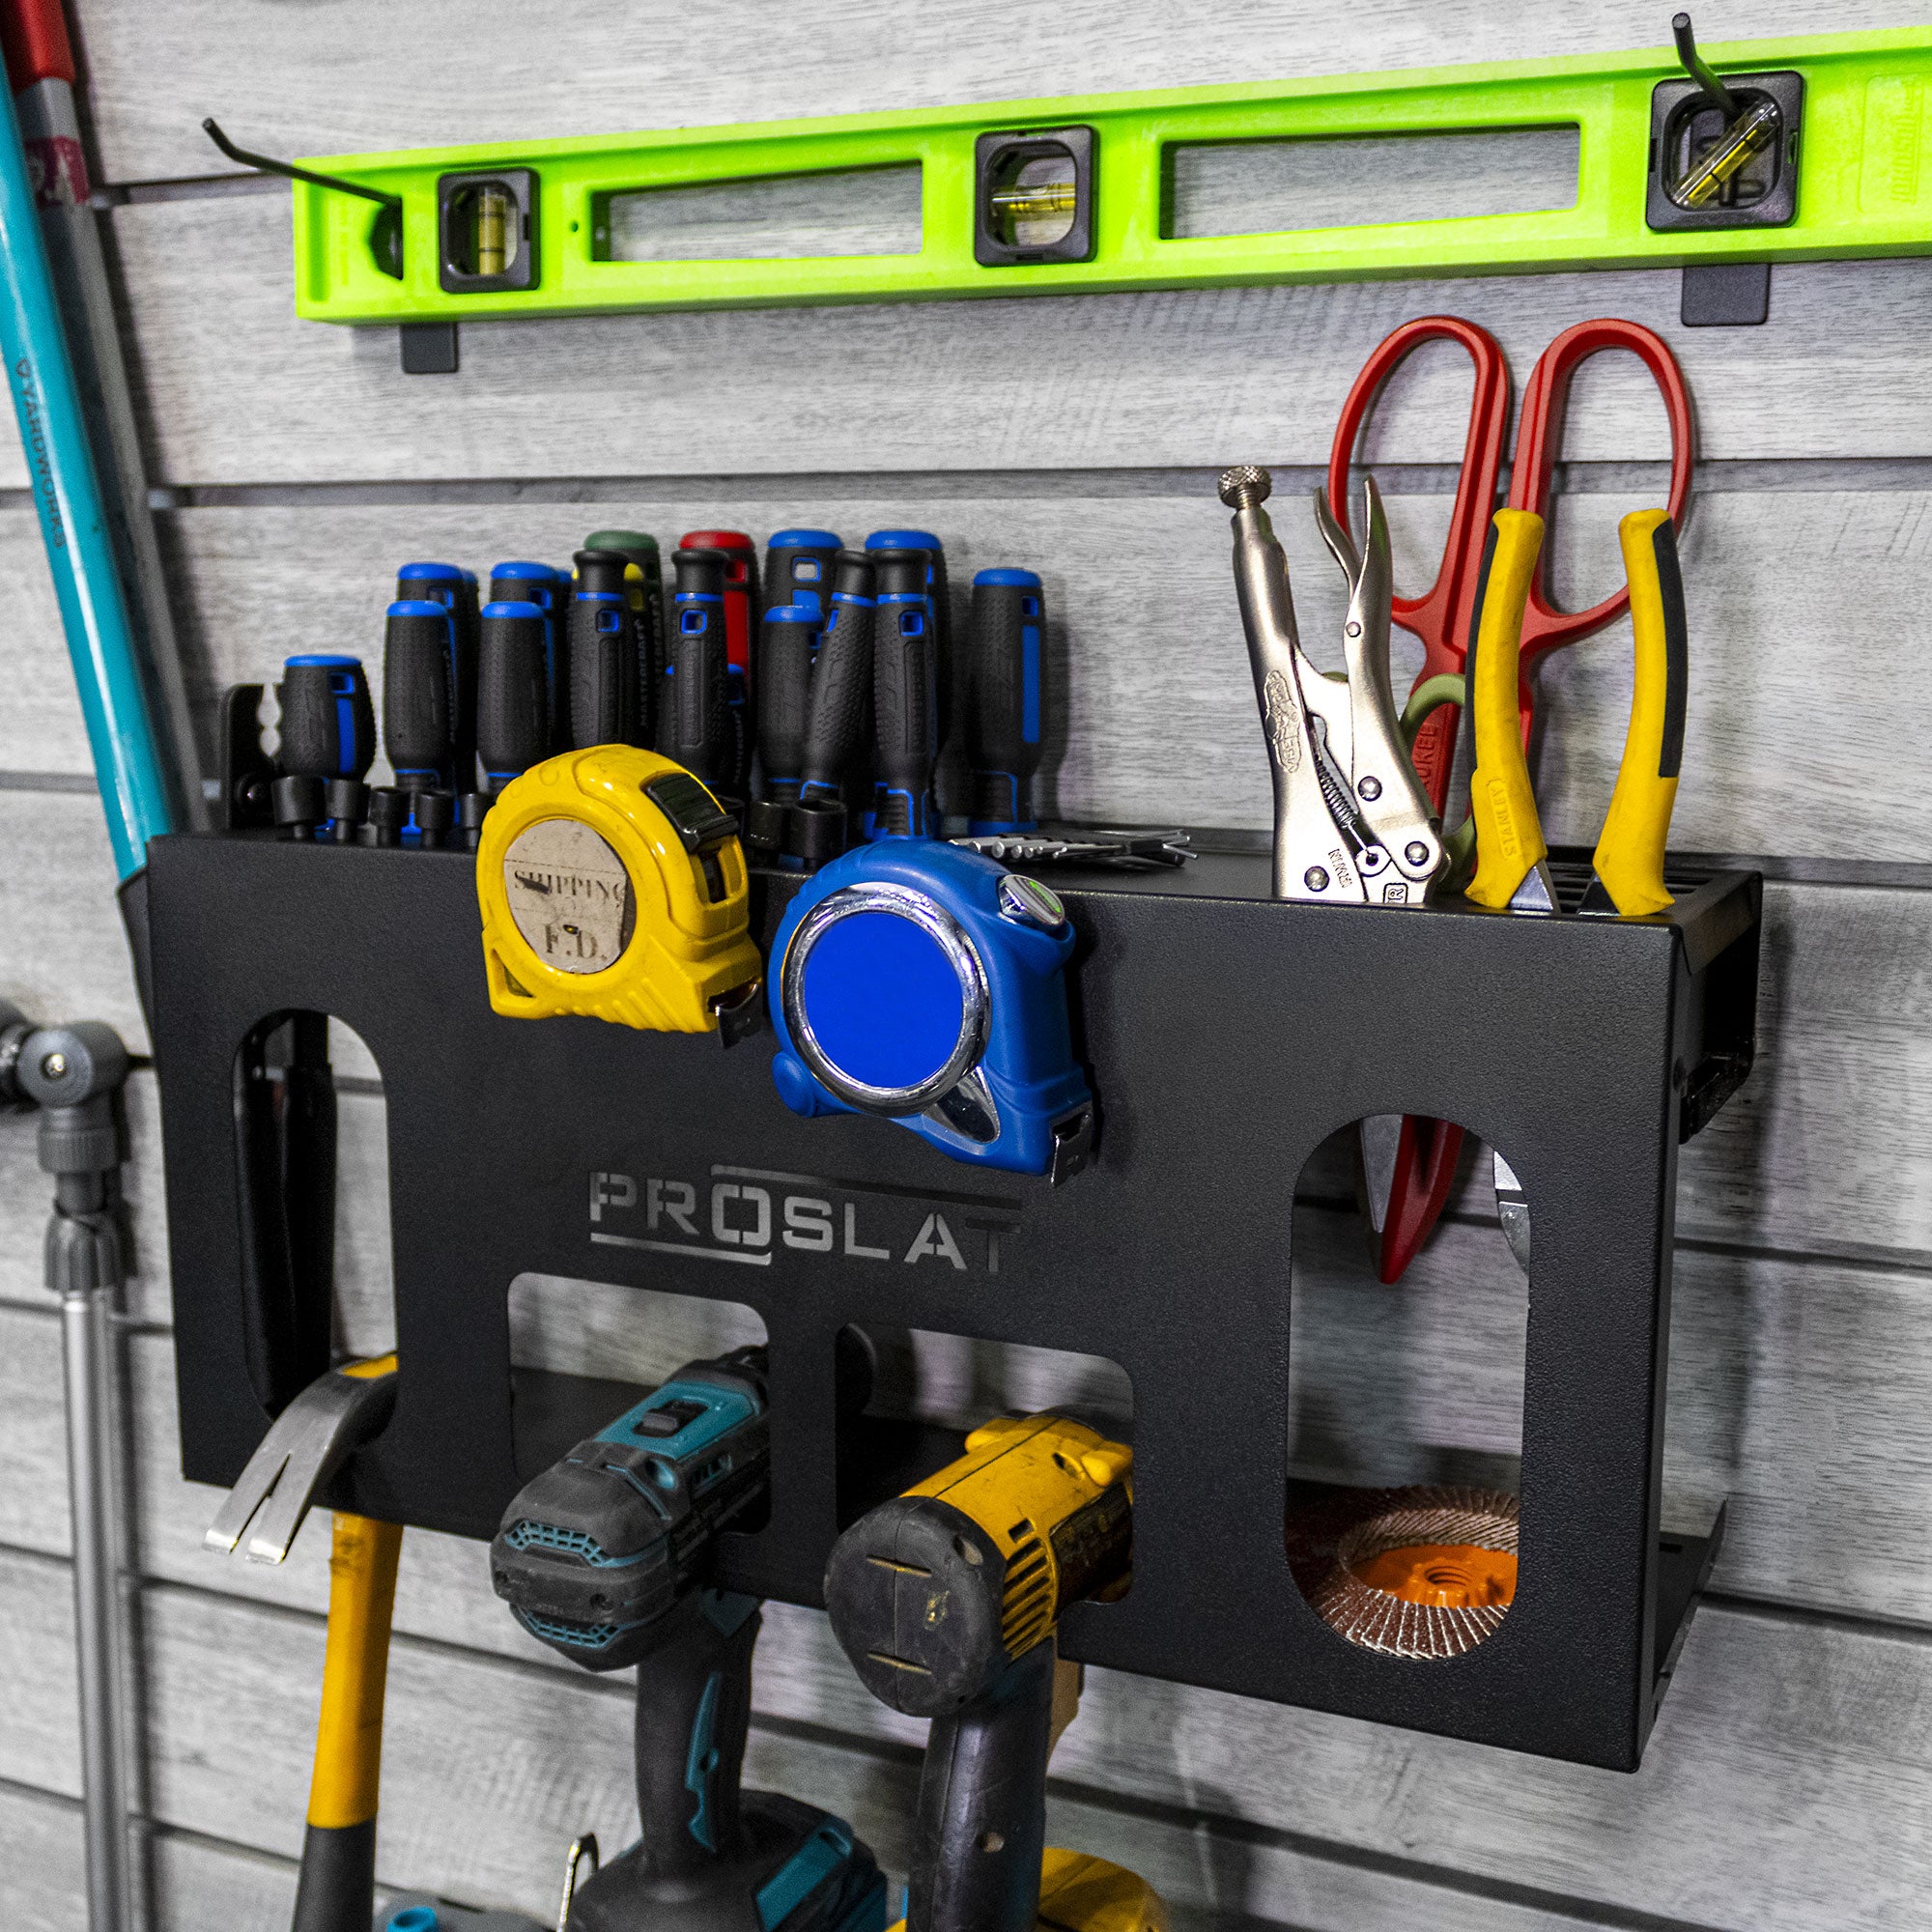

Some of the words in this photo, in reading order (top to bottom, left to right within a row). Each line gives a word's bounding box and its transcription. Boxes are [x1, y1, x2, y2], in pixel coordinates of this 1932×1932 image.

[20, 385, 67, 548] YARDWORKS
[1491, 786, 1518, 857] STANLEY
[514, 869, 621, 909] SHIPPING
[590, 1169, 1021, 1273] PROSLAT
